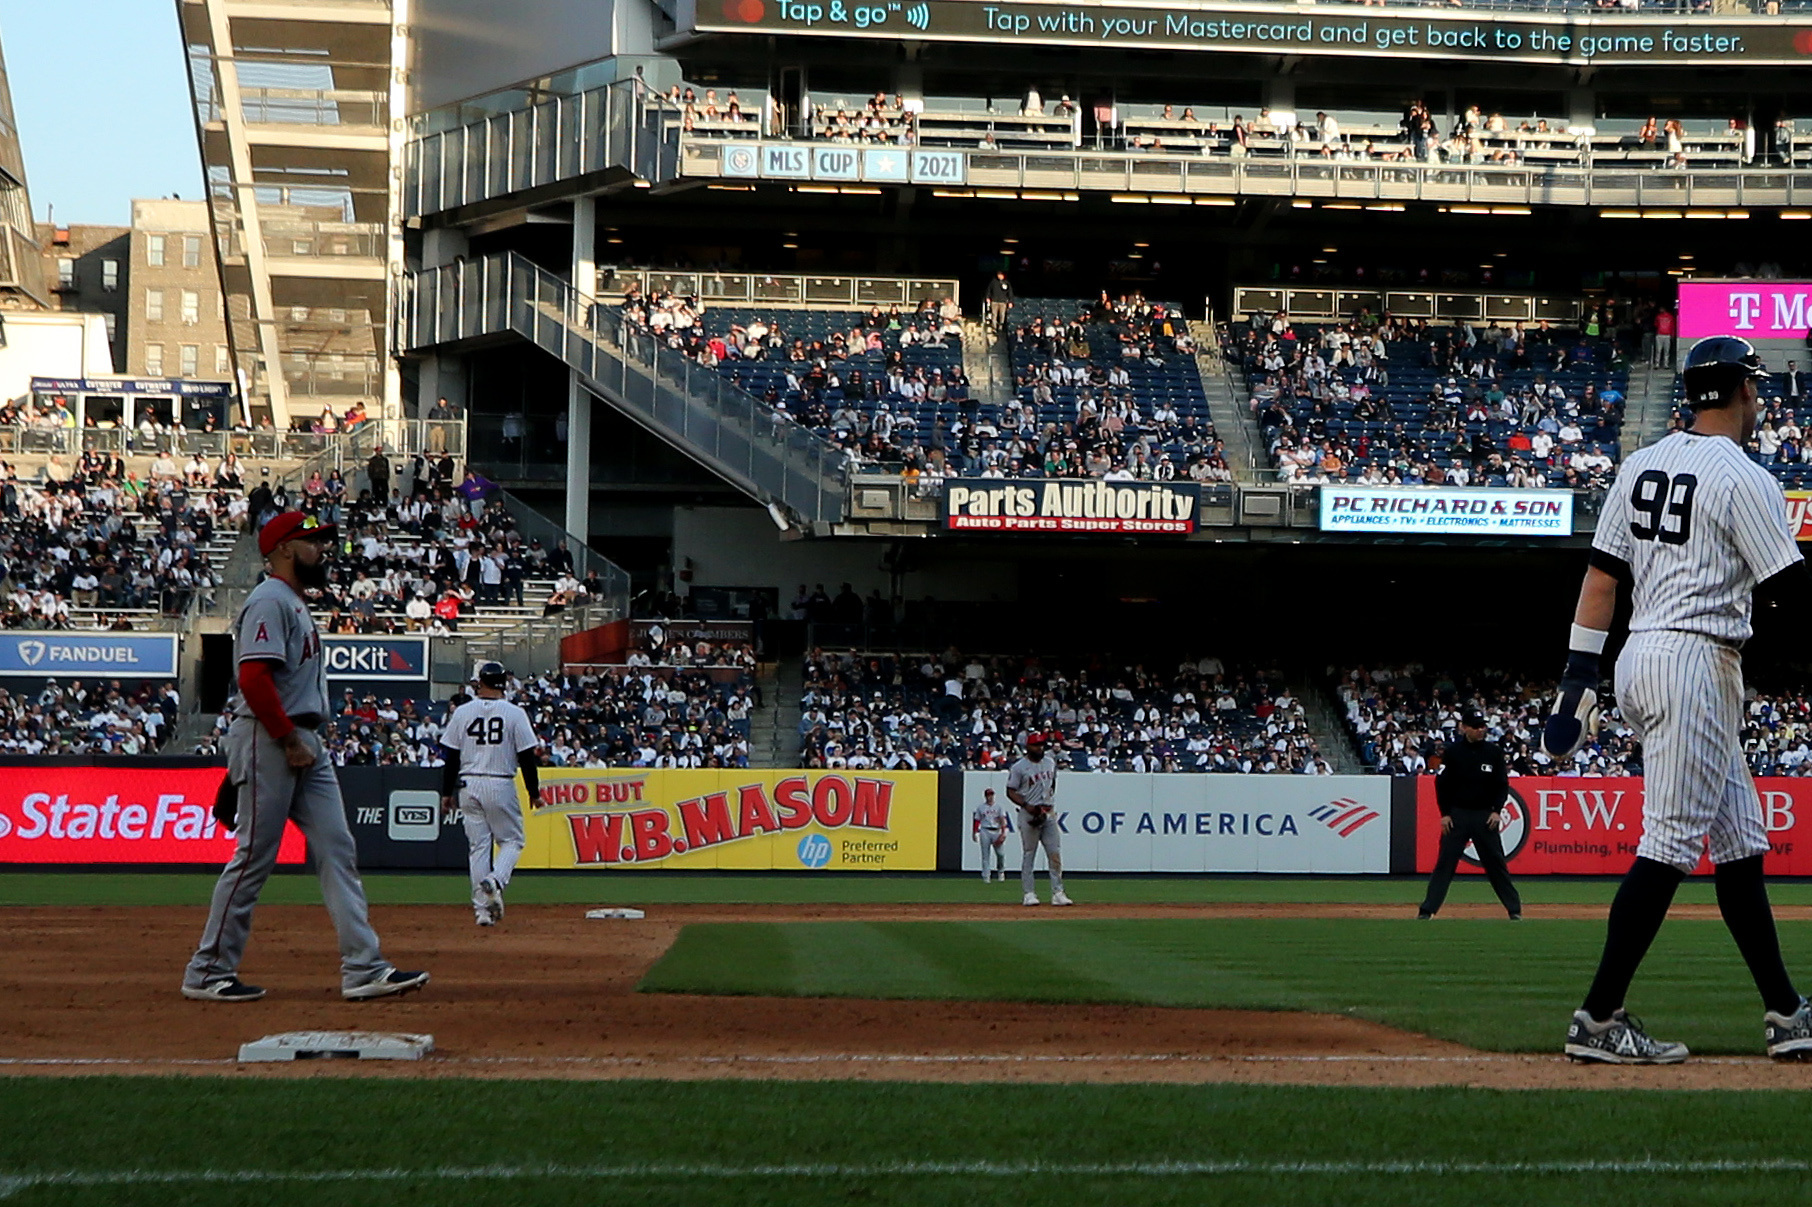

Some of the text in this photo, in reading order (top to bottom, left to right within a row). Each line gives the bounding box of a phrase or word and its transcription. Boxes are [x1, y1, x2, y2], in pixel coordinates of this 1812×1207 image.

[829, 0, 849, 22] &
[984, 6, 1745, 57] Tap with your Mastercard and get back to the game faster.
[769, 150, 958, 177] MLS CUP 2021
[949, 481, 1194, 521] Parts Authority
[1490, 499, 1508, 515] &
[1513, 500, 1563, 516] SON
[1630, 469, 1698, 545] 99
[956, 516, 1187, 532] Auto Parts Super Stores
[1331, 515, 1390, 525] APPLIANCES
[1426, 516, 1490, 527] ELECTRONICS
[1500, 518, 1561, 528] MATTRESSES
[255, 622, 269, 642] A
[49, 645, 139, 664] FANDUEL
[466, 717, 505, 746] 48
[539, 780, 645, 807] WHO BUT
[356, 807, 385, 825] THE
[400, 809, 429, 821] YES
[1535, 789, 1626, 831] F.W.
[1082, 811, 1124, 835] OF
[1136, 811, 1300, 836] AMERICA
[800, 834, 830, 869] hp
[842, 840, 898, 856] Preferred
[842, 851, 886, 865] Partner
[1533, 841, 1612, 857] Plumbing,
